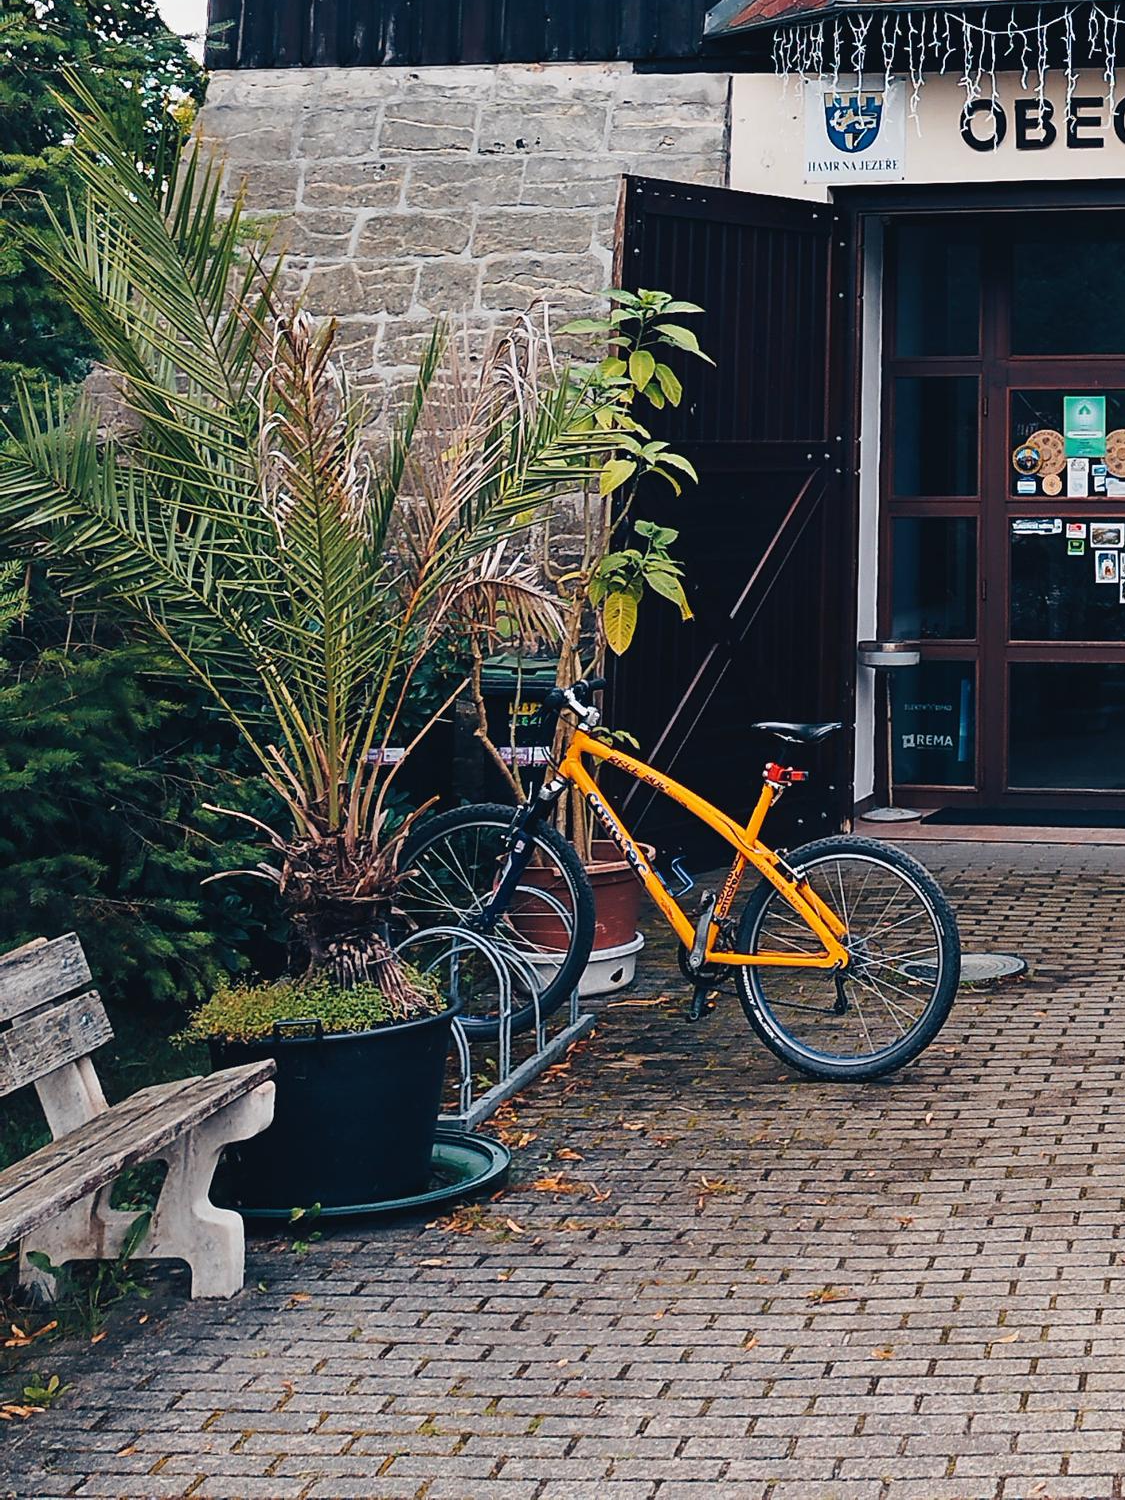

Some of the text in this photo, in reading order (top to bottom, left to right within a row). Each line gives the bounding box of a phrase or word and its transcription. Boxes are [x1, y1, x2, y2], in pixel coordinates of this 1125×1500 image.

[808, 157, 899, 172] HAMR NA JEZEŘE
[916, 734, 953, 747] REMA
